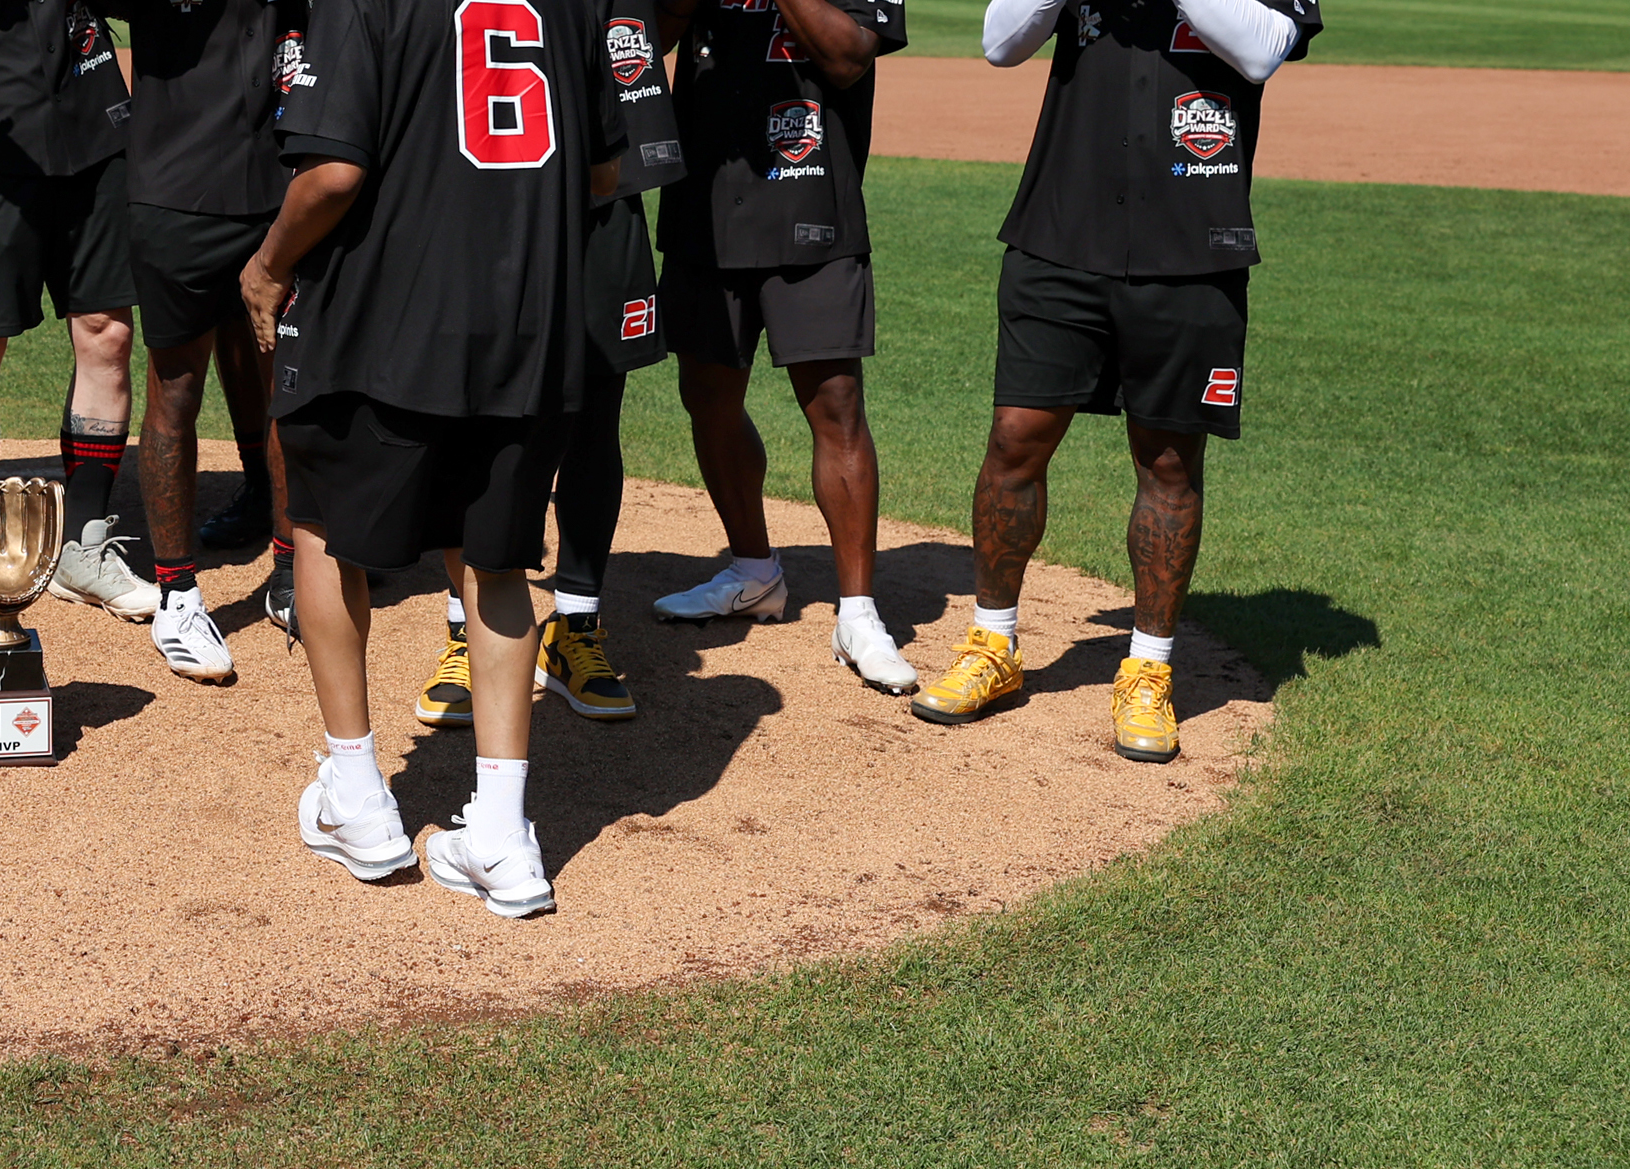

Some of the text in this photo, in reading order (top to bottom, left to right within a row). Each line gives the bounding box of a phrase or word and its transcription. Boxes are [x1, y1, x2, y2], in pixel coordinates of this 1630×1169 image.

[606, 33, 650, 53] ENZEL
[619, 84, 662, 104] akprints
[768, 114, 823, 134] DENZEL
[1173, 109, 1234, 128] DENZEL
[1190, 123, 1220, 133] WARD
[778, 165, 825, 180] jakprints
[1185, 162, 1239, 178] jakprints
